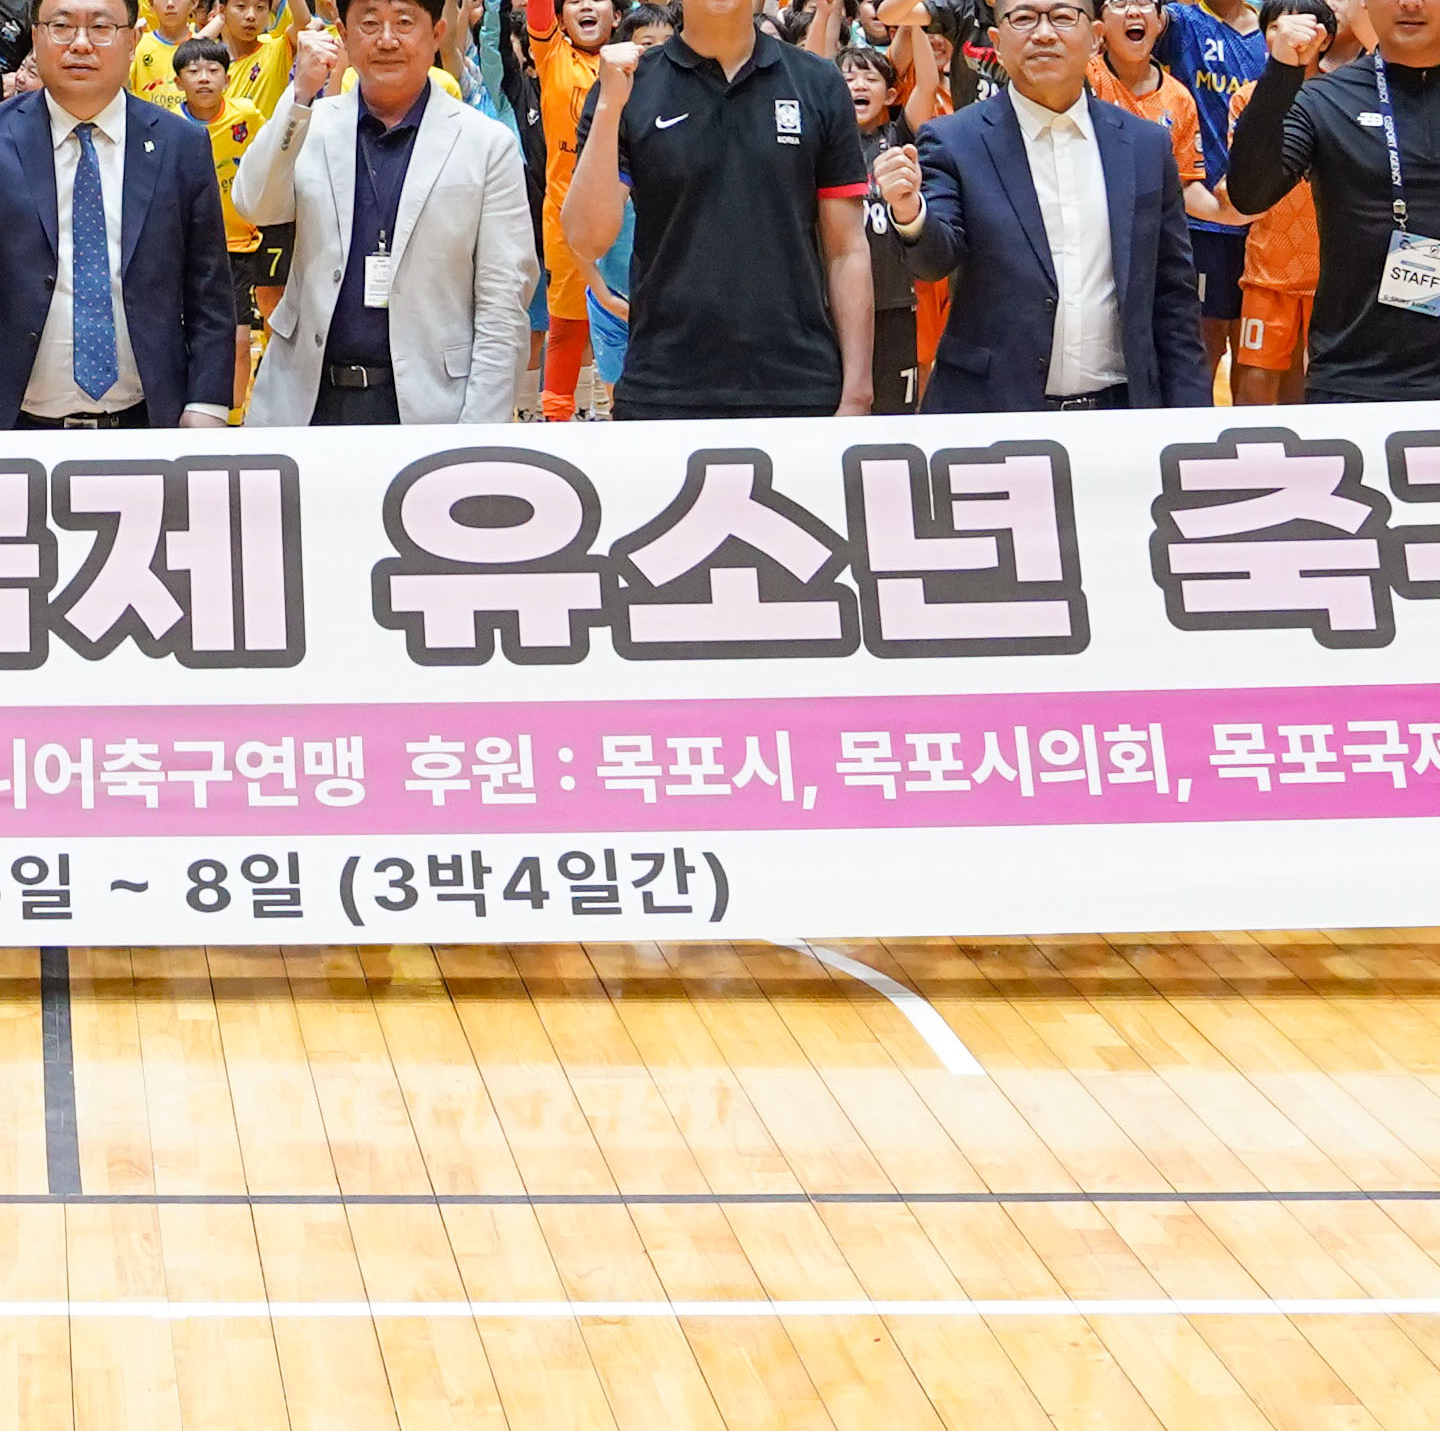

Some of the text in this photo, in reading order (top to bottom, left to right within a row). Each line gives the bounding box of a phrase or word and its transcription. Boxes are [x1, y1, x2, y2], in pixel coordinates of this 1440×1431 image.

[1205, 38, 1224, 61] 21
[1390, 266, 1440, 290] STAFF
[1239, 317, 1265, 351] 10
[371, 439, 1091, 666] 유소년
[404, 733, 537, 807] 후원
[596, 730, 818, 810] 목포시,
[835, 722, 1192, 804] 목포시의회,
[184, 852, 302, 921] 8일
[339, 847, 729, 926] (3박4일간)
